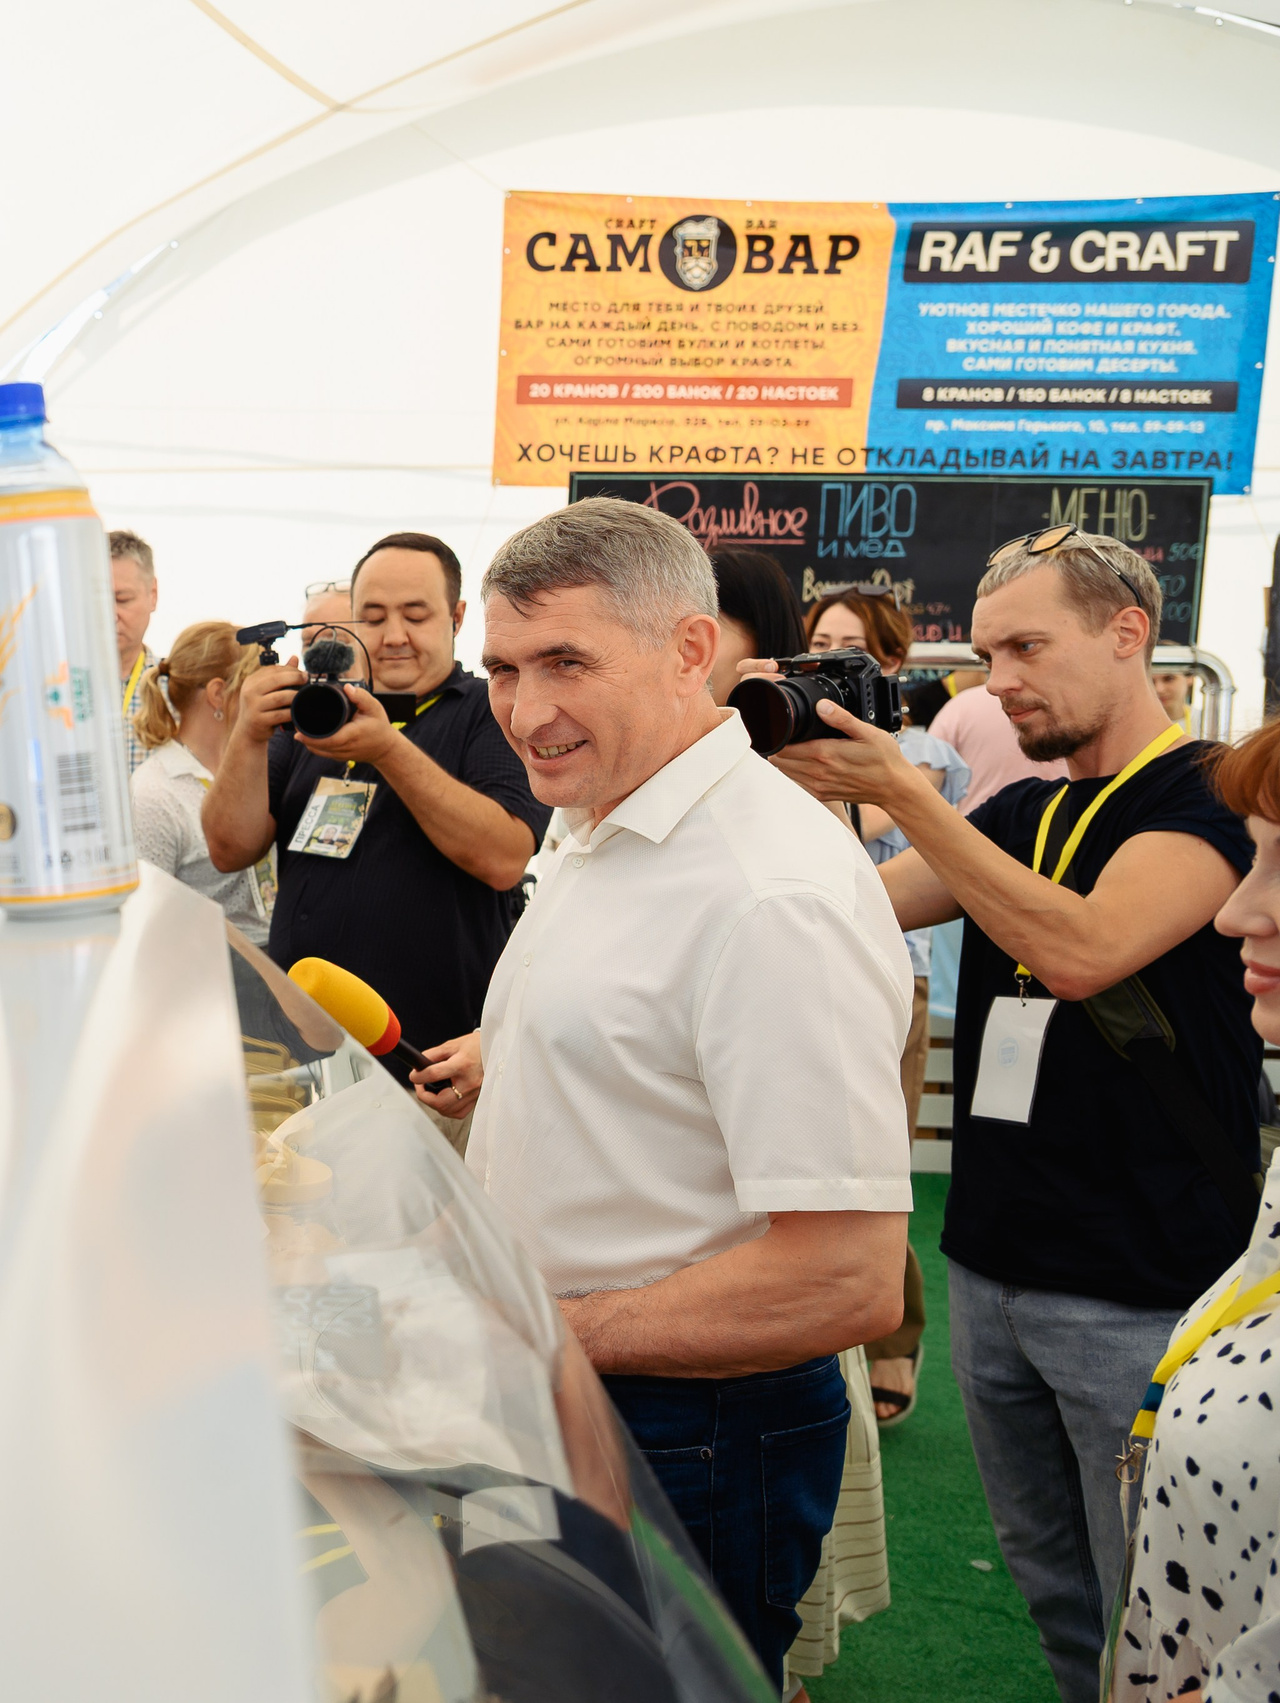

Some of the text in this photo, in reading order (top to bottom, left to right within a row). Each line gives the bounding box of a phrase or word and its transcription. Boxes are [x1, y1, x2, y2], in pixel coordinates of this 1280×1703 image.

[918, 230, 1240, 273] RAF & CRAFT
[919, 304, 989, 317] УЮТНОЕ
[992, 304, 1079, 317] МЕСТЕЧКО
[1085, 304, 1154, 317] НАШЕГО
[966, 319, 1053, 335] ХОРОШИЙ
[1056, 322, 1103, 335] КОФЕ
[946, 340, 1025, 353] ВКУСНАЯ
[1044, 340, 1135, 354] ПОНЯТНАЯ
[963, 358, 1013, 371] САМИ
[1016, 358, 1093, 372] ГОТОВИМ
[529, 383, 551, 398] 20
[553, 383, 619, 399] КРАНОВ
[632, 383, 663, 399] 200
[665, 384, 723, 399] БАНОК
[736, 385, 759, 400] 20
[761, 385, 839, 400] НАСТОЕК
[936, 388, 1004, 402] КРАНОВ
[1049, 389, 1106, 403] БАНОК
[1134, 390, 1212, 404] НАСТОЕК
[517, 443, 1233, 471] ХОЧЕШЬ КРАФТА? НЕ ОТКЛАДЫВАЙ НА ЗАВТРА!
[819, 483, 917, 538] ПИВО
[294, 804, 321, 844] ПРЕССА
